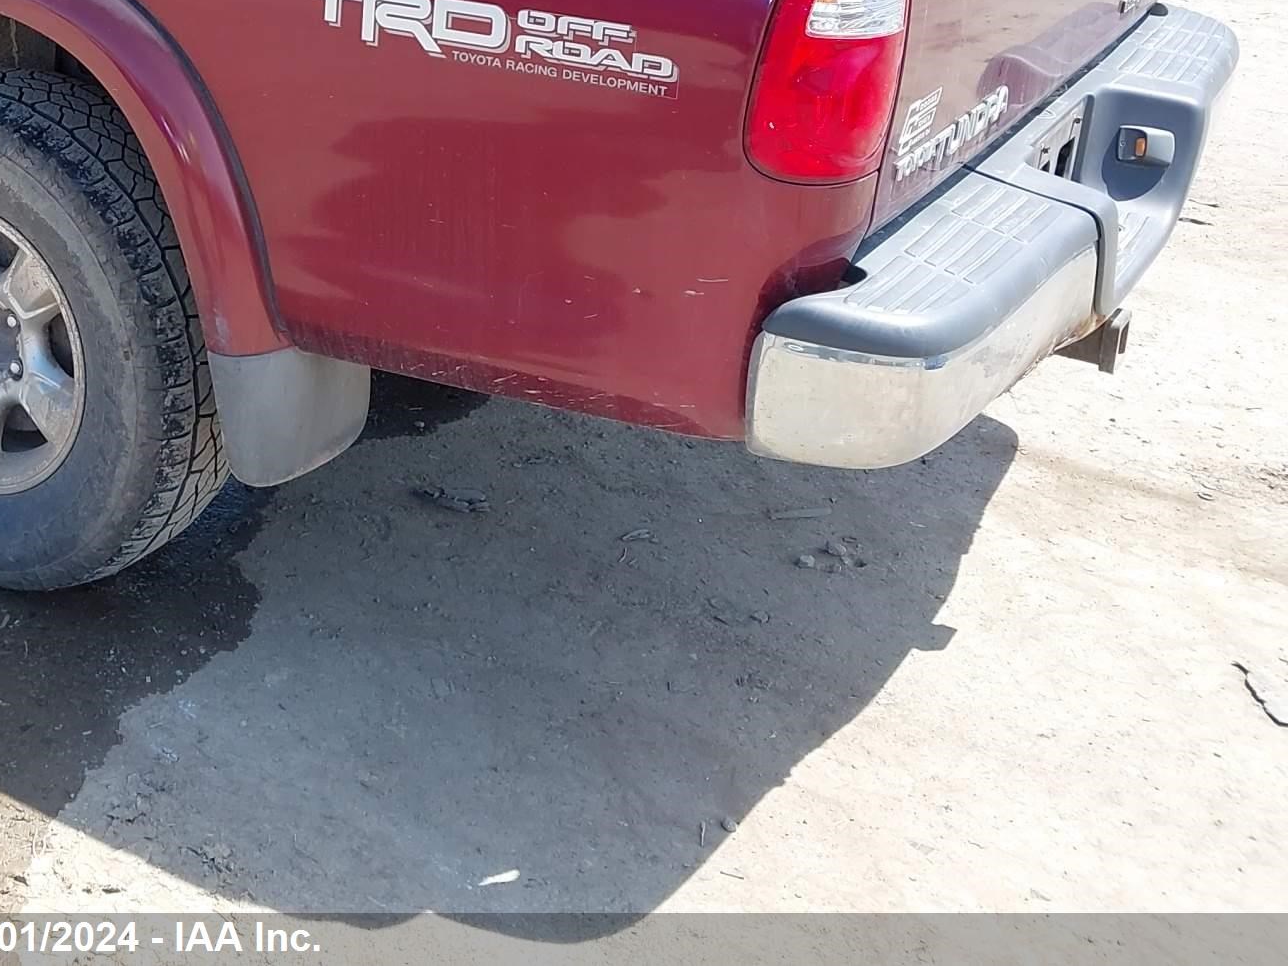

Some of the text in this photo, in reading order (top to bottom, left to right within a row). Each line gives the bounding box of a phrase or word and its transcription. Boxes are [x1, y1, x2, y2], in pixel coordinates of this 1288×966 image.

[517, 8, 636, 46] OFF
[451, 50, 668, 98] TOYOTA RACING DEVELOPMENT
[514, 34, 680, 83] ROAD
[932, 84, 1009, 163] TUNDRA
